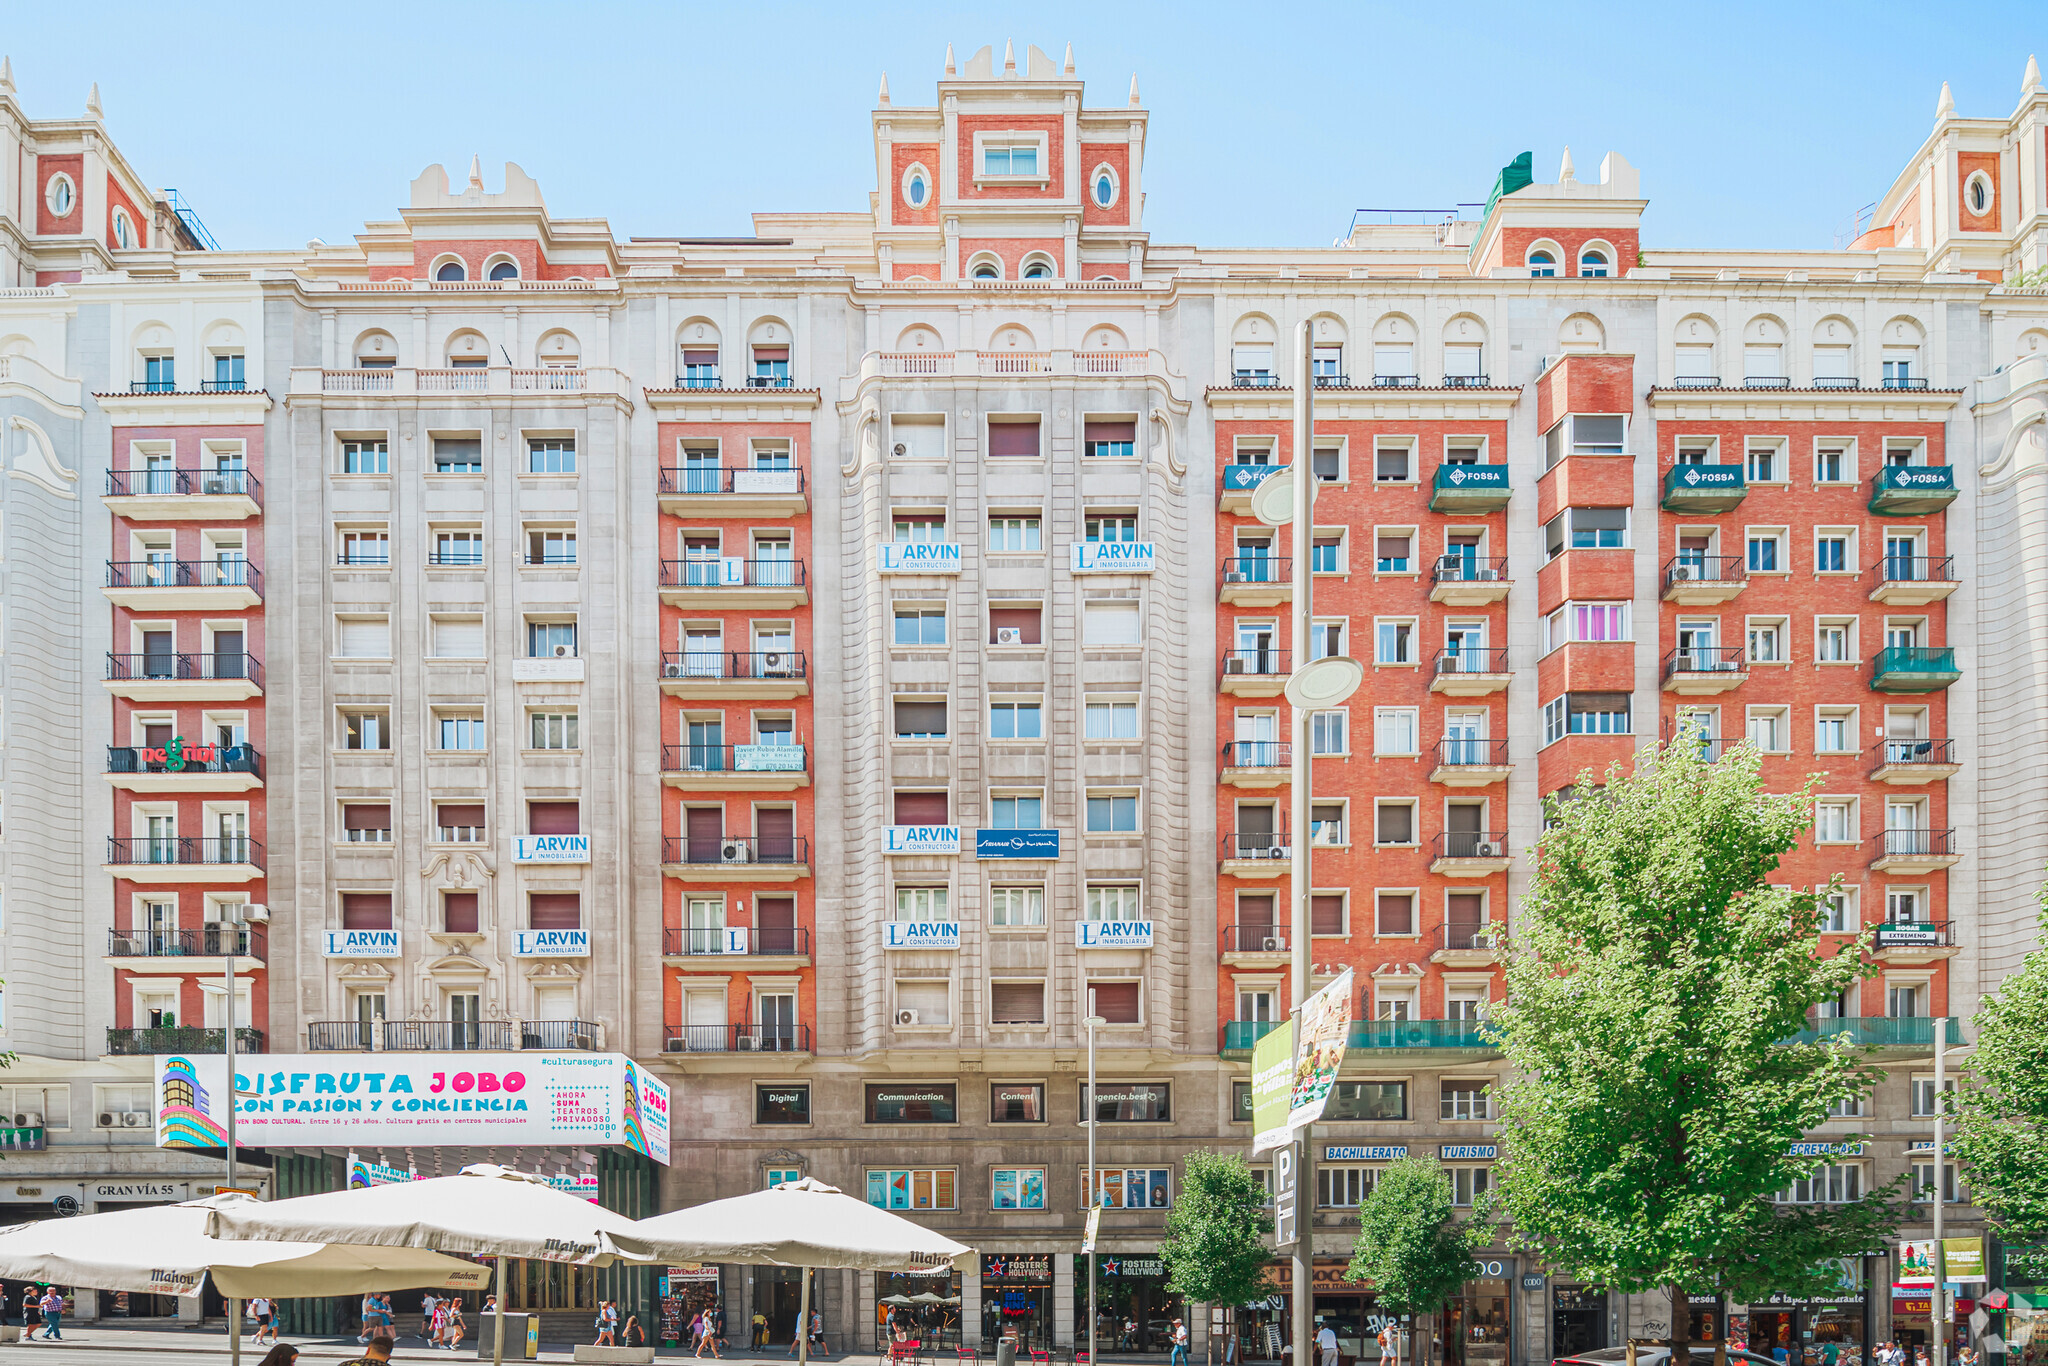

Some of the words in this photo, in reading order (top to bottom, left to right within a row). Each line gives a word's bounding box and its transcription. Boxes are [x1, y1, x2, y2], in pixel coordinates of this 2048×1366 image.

[1467, 472, 1500, 480] FOSSA
[1701, 473, 1735, 482] FOSSA
[1912, 474, 1946, 483] FOSSA
[726, 561, 740, 581] L
[142, 736, 216, 771] negrini
[729, 931, 743, 951] L
[542, 1058, 613, 1068] #culturasegura
[234, 1071, 414, 1096] DISFRUTA
[429, 1071, 526, 1094] JOBO
[643, 1087, 667, 1113] JOBO
[768, 1094, 799, 1103] Digital
[877, 1093, 944, 1101] Communication
[1000, 1092, 1034, 1100] Content
[234, 1099, 274, 1112] CON
[283, 1094, 362, 1113] PASIÓN
[370, 1099, 383, 1112] Y
[391, 1098, 528, 1112] CONCIENCIA
[386, 1117, 414, 1125] Cultura
[417, 1118, 441, 1126] gratis
[485, 1117, 527, 1126] municipales
[1328, 1147, 1406, 1159] BACHILLERATO
[1444, 1146, 1495, 1157] TURISMO
[1279, 1149, 1291, 1191] P
[97, 1185, 134, 1196] GRAN
[136, 1183, 158, 1196] VÍA
[161, 1185, 174, 1195] 55
[544, 1238, 597, 1255] Mahou
[1009, 1261, 1049, 1269] FOSTER'S
[448, 1271, 479, 1280] Mahou
[700, 1267, 718, 1275] G-VIA
[1009, 1268, 1049, 1276] HOLLYWOOD
[1123, 1268, 1163, 1276] HOLLYWOOD
[151, 1269, 194, 1285] Mahou
[1524, 1278, 1542, 1286] CODO
[1004, 1292, 1024, 1301] BIG
[1769, 1294, 1781, 1303] de
